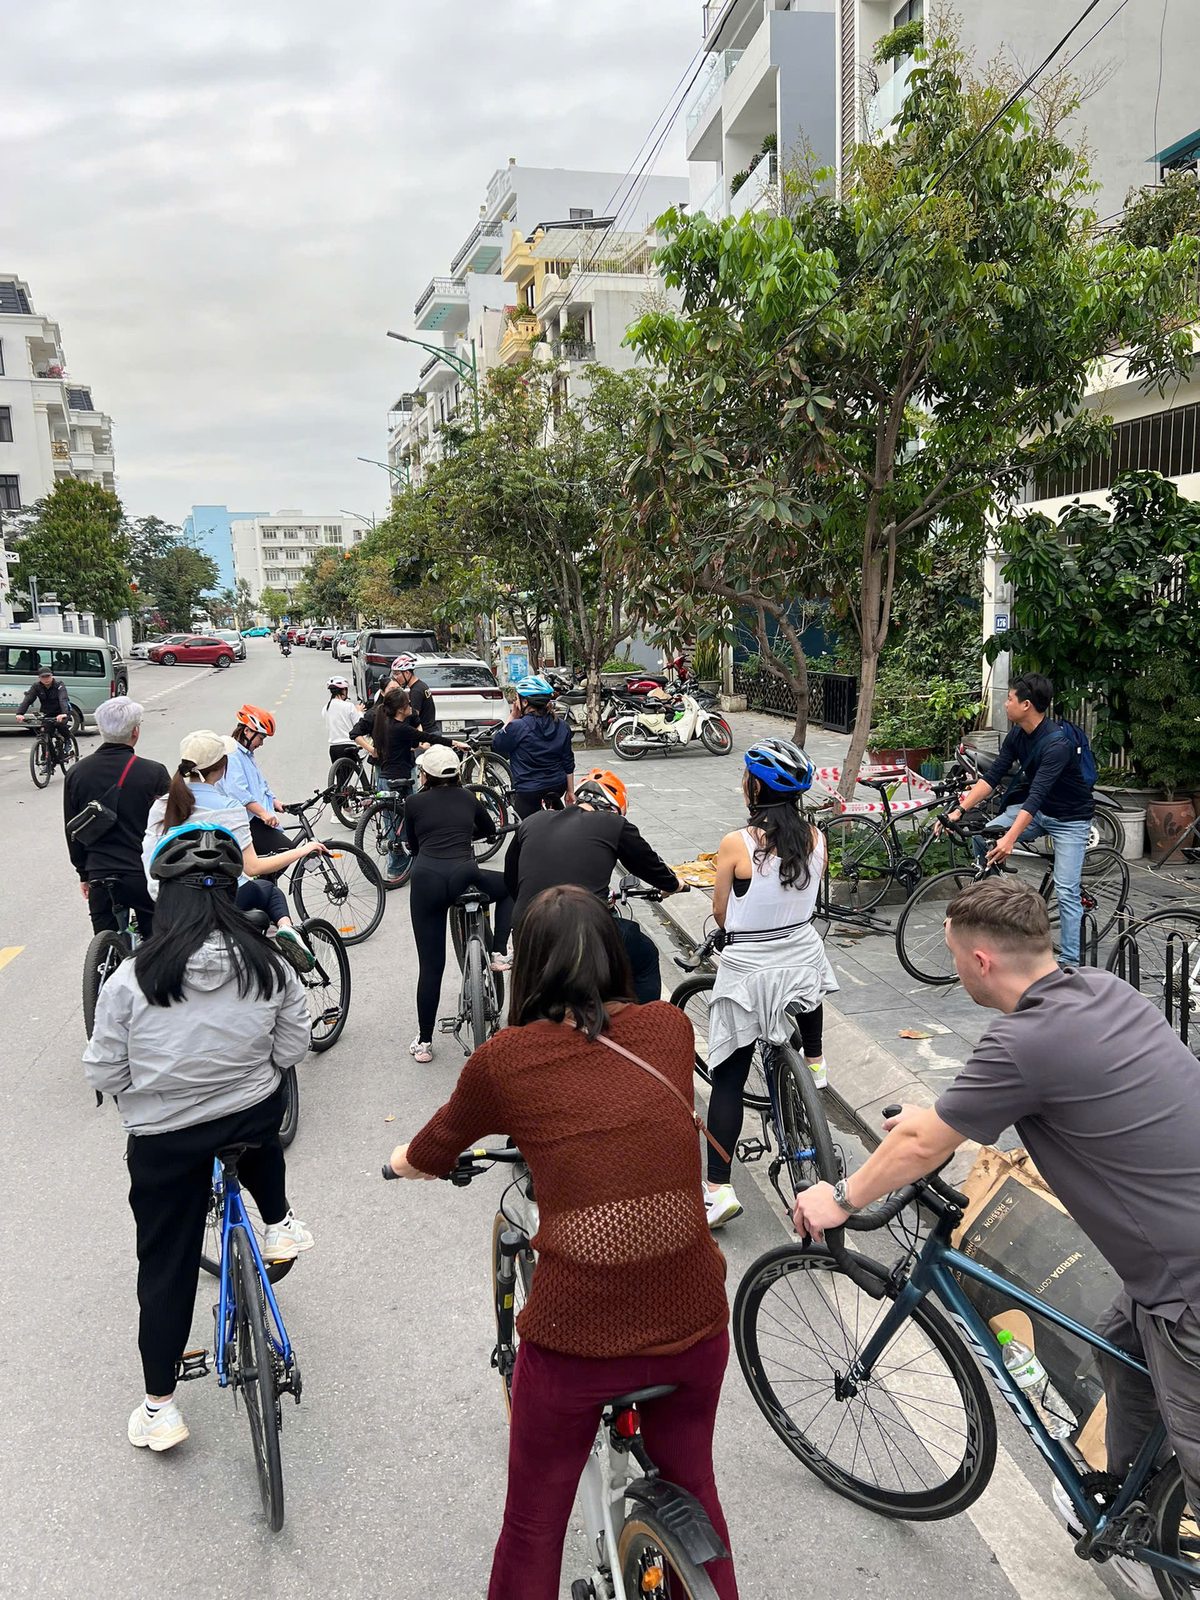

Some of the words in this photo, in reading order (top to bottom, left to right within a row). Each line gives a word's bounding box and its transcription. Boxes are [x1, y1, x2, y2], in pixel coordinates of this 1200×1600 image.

[1035, 1252, 1083, 1294] MERIDA.com
[848, 1360, 865, 1387] SCR
[949, 1311, 1056, 1463] GIANT
